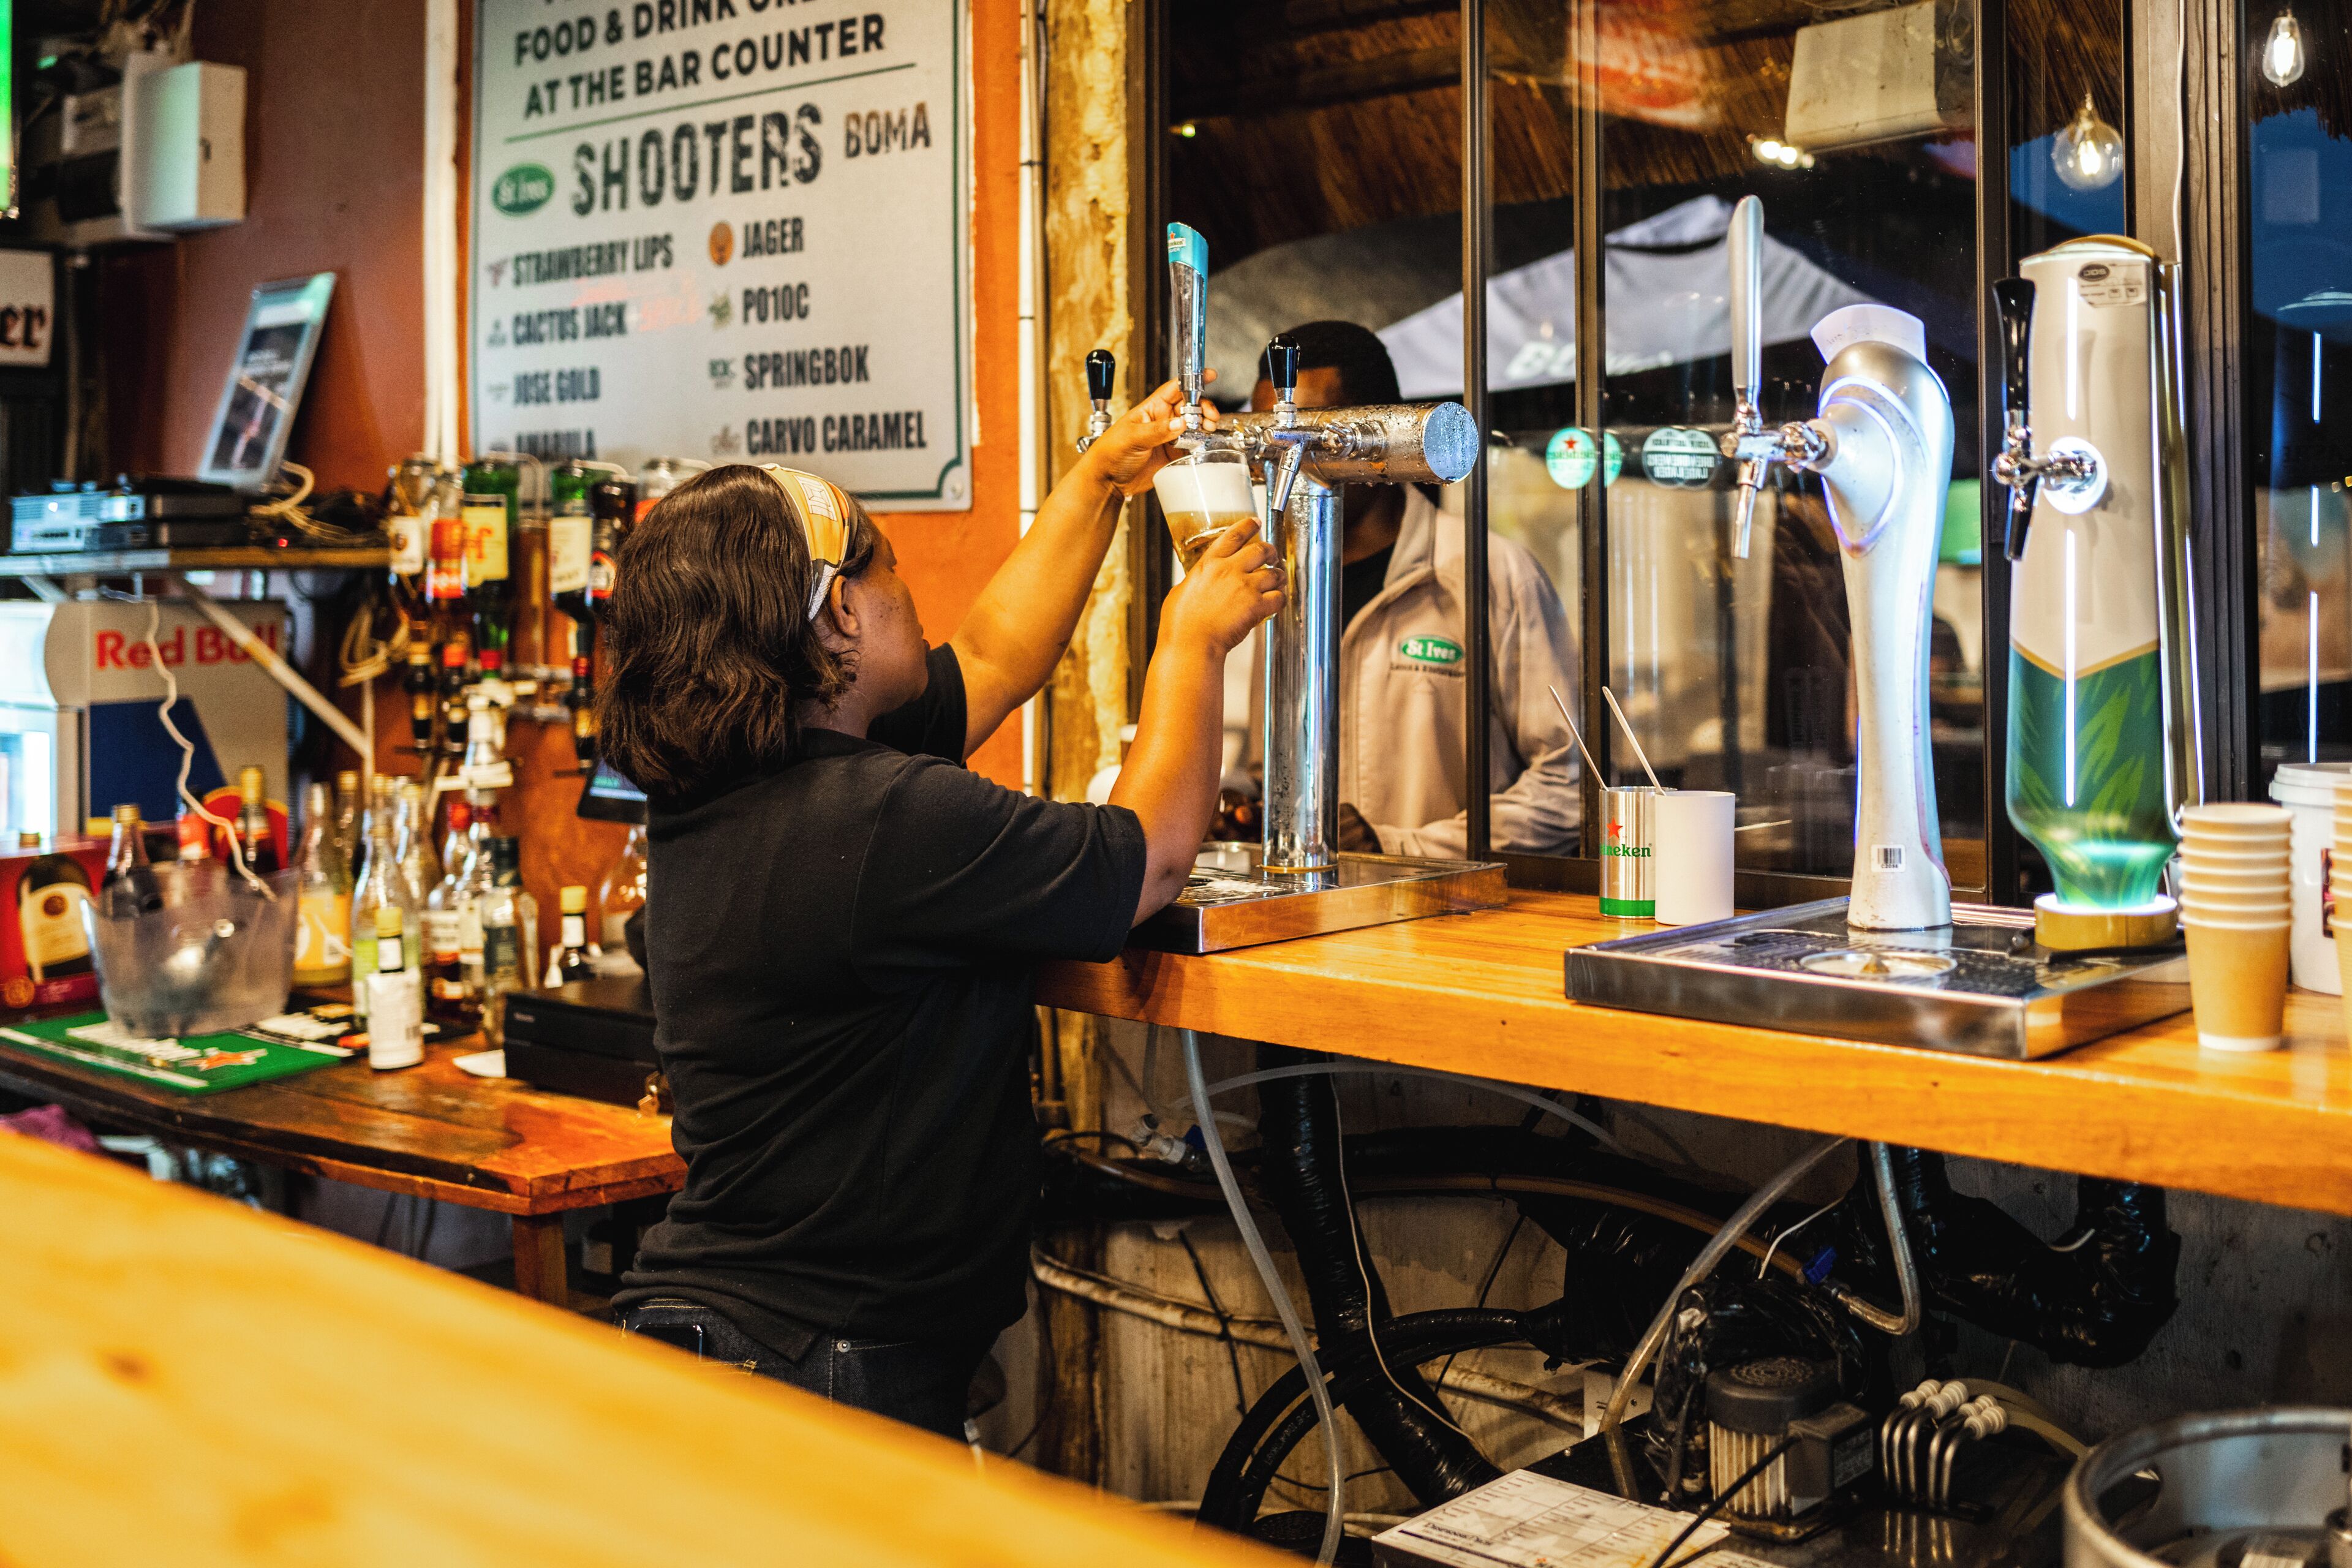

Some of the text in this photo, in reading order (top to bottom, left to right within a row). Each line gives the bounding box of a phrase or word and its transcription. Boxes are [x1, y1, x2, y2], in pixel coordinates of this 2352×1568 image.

[514, 0, 737, 67] FOOD & DRINK
[524, 13, 885, 119] AT THE BAR COUNTER
[844, 102, 932, 159] BOMA
[571, 102, 823, 217] SHOOTERS
[513, 232, 673, 287] STRAWBERRY LIPS
[742, 216, 804, 258] JAGER
[513, 300, 627, 346] CACTUS JACK
[744, 344, 870, 390] SPRINGBOK
[747, 415, 816, 455] CARVO
[823, 409, 927, 452] CARAMEL
[96, 625, 185, 670] Red
[1407, 639, 1456, 660] St Ives
